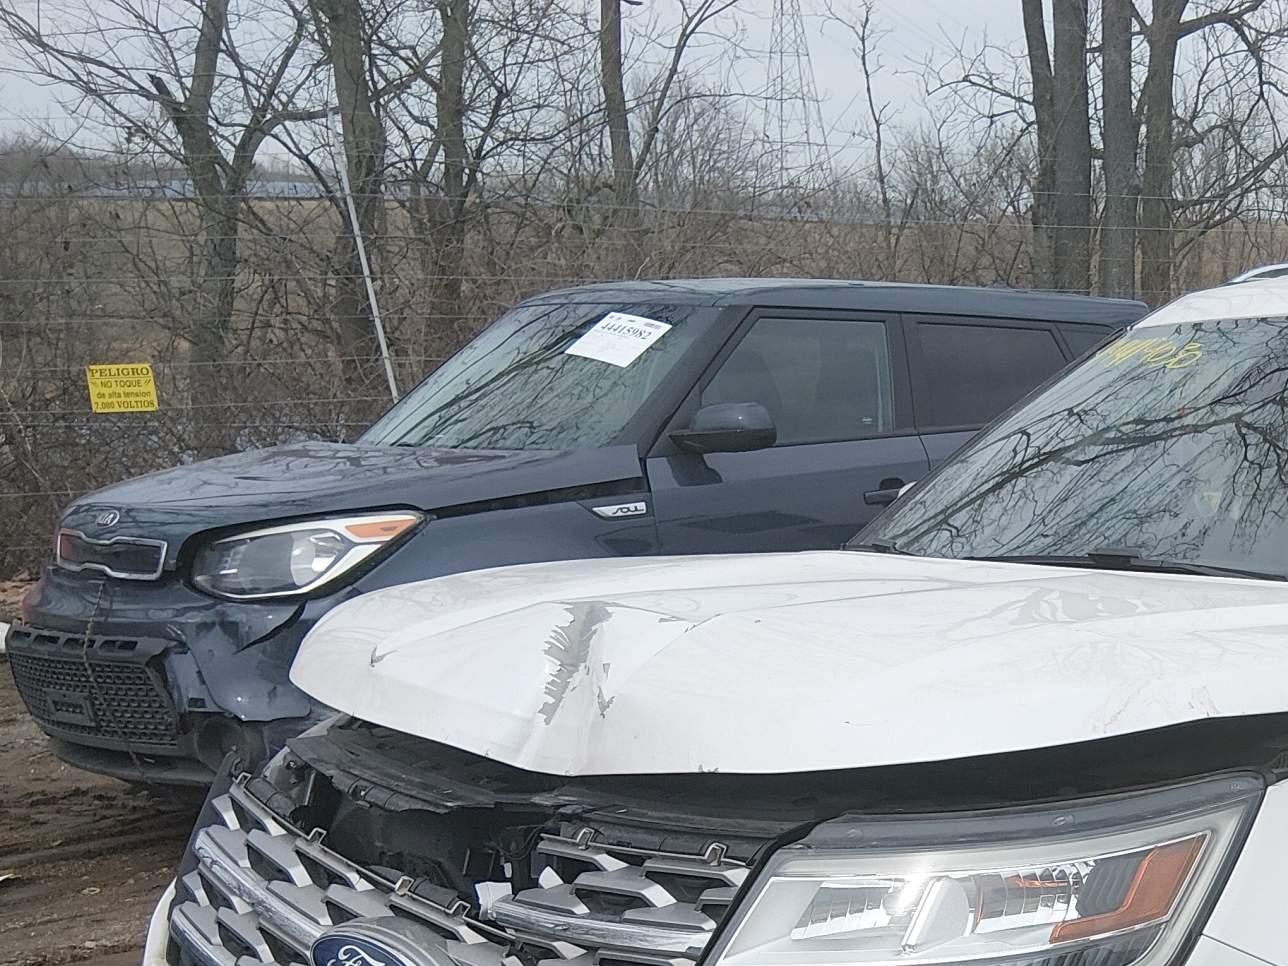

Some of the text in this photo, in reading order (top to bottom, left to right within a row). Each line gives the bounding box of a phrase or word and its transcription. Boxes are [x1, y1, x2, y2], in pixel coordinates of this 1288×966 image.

[91, 367, 150, 377] PELIGRO
[101, 379, 142, 388] NO TOQUE
[108, 391, 121, 399] alta
[95, 400, 155, 409] 7.000 VOLTIOS
[612, 505, 645, 515] SOUL
